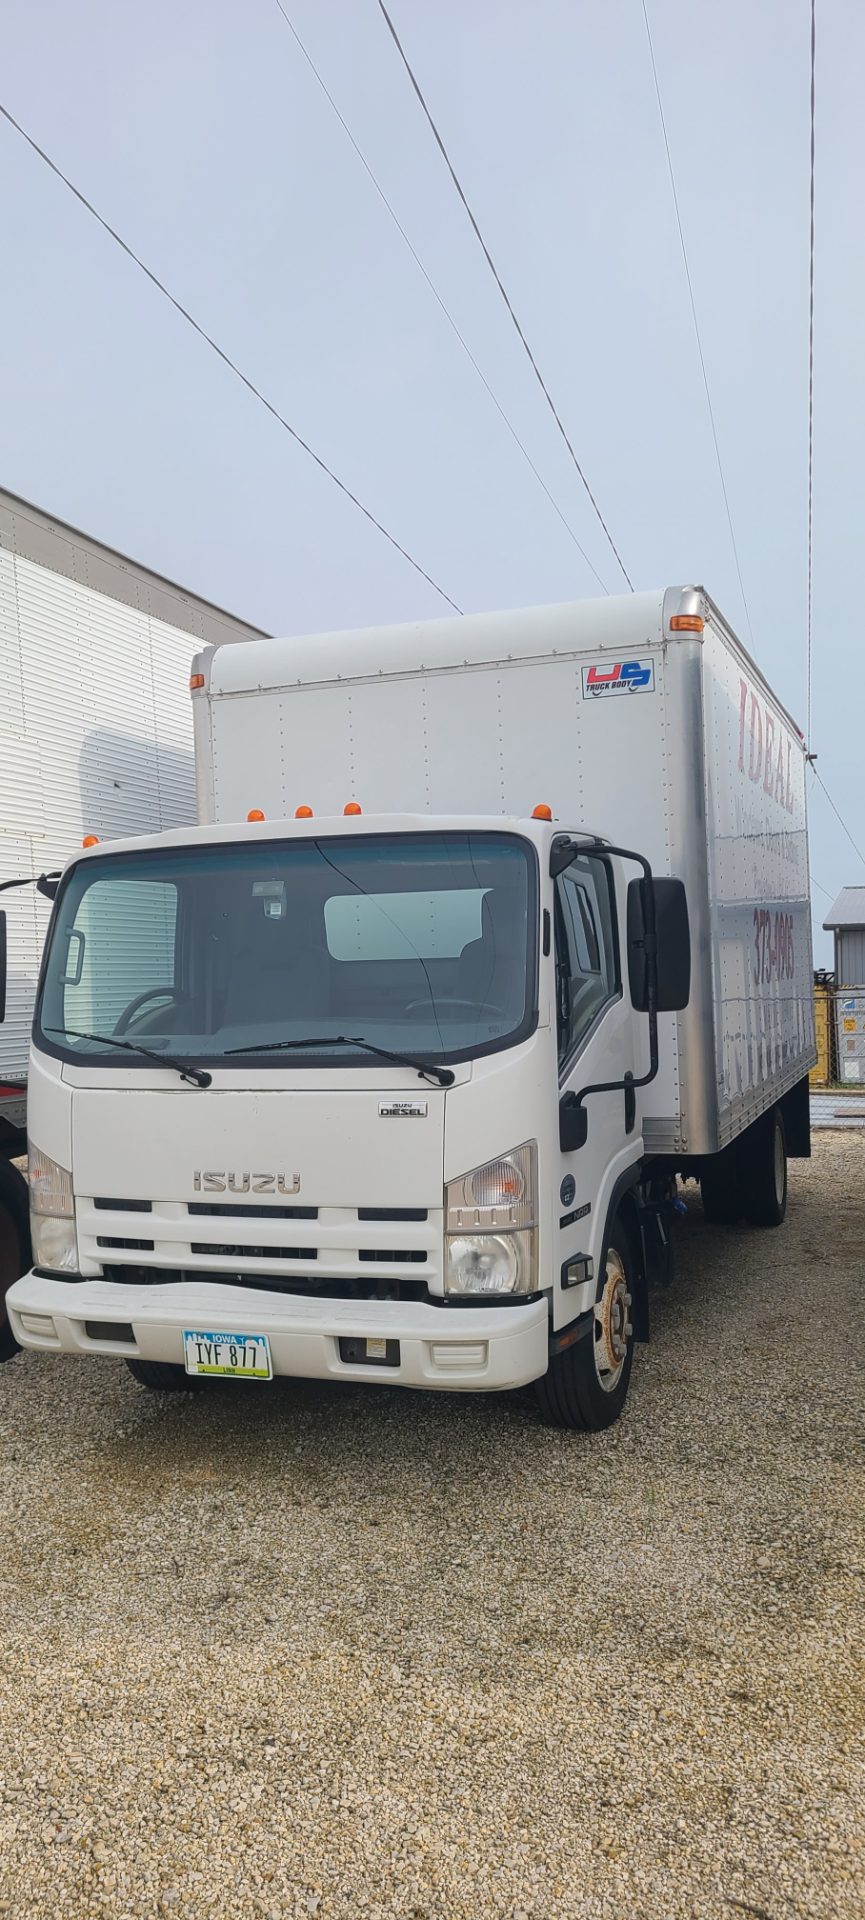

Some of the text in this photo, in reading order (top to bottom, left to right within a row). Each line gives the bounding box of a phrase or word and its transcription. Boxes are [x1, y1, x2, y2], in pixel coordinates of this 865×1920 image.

[586, 680, 632, 692] TRUCK BODY
[587, 662, 651, 686] US
[738, 678, 794, 815] IDEAL
[381, 1108, 424, 1116] DIESEL
[194, 1170, 301, 1195] ISUZU
[212, 1334, 237, 1344] IOWA
[195, 1343, 257, 1368] IYF 877
